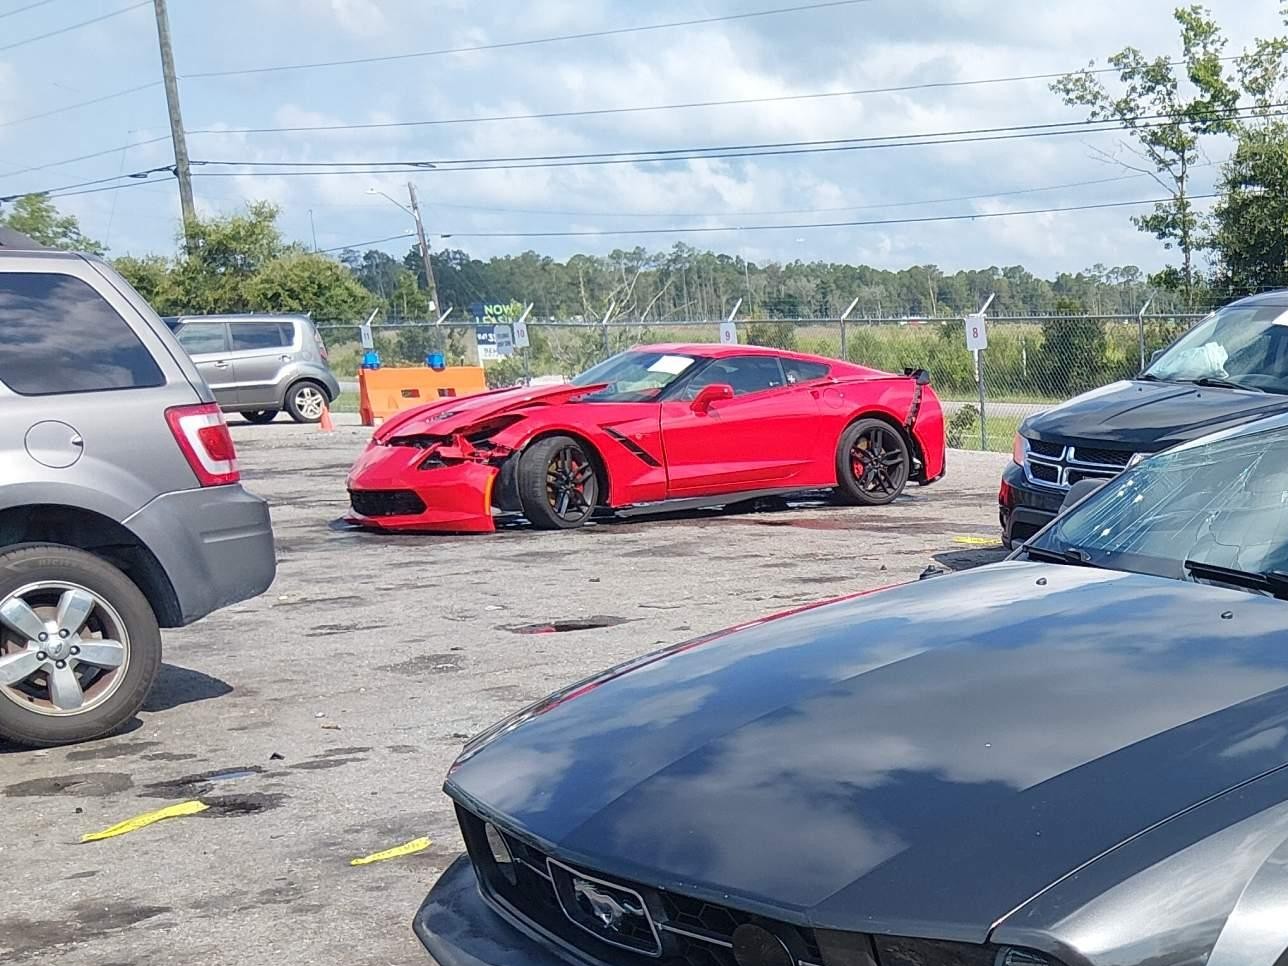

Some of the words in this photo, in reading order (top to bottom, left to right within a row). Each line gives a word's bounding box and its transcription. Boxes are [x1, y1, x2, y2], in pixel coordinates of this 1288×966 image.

[484, 304, 513, 315] NOW
[516, 329, 525, 338] 10
[725, 331, 730, 341] 9
[973, 327, 978, 338] 8
